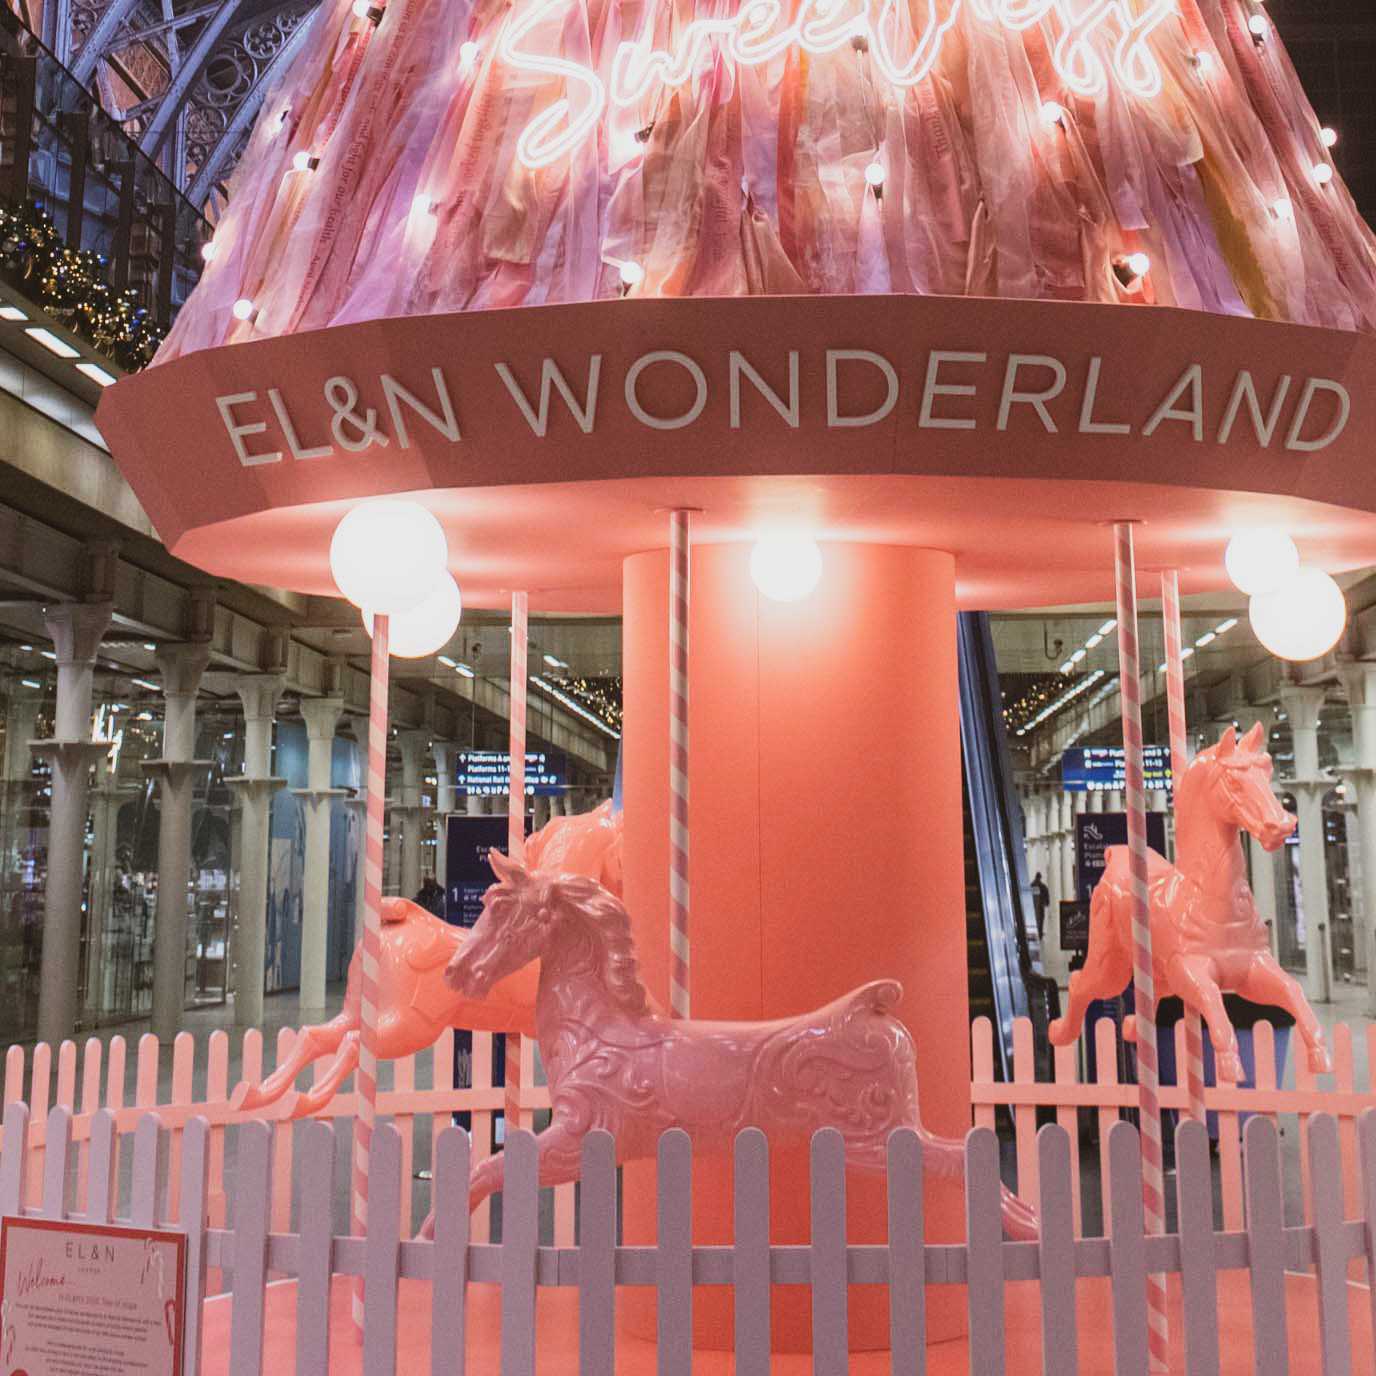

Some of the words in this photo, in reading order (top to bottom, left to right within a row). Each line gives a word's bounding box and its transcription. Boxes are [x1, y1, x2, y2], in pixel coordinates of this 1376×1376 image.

[320, 207, 338, 244] health
[215, 367, 461, 468] EL&N
[494, 349, 1351, 453] WONDERLAND
